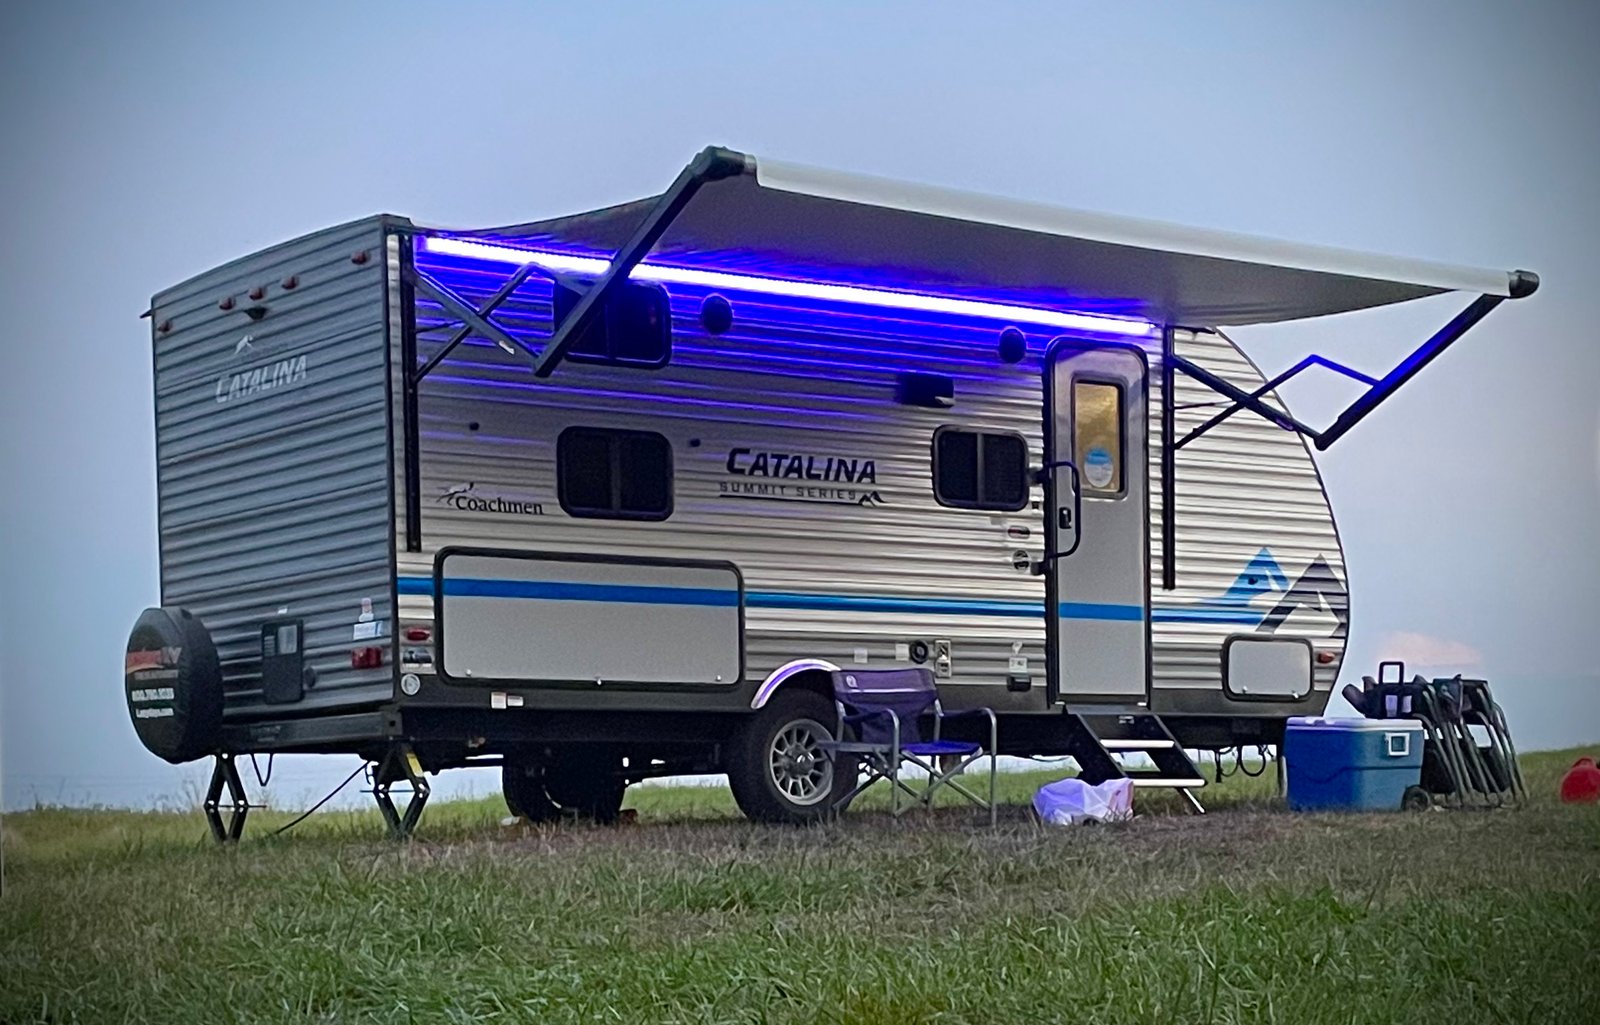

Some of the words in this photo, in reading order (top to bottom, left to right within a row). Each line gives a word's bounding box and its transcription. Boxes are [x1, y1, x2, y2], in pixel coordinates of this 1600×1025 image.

[216, 355, 306, 403] CATALINA
[726, 448, 876, 484] CATALINA
[719, 481, 786, 496] SUMMIT
[796, 487, 856, 500] SERIES
[455, 496, 544, 515] Coachmen
